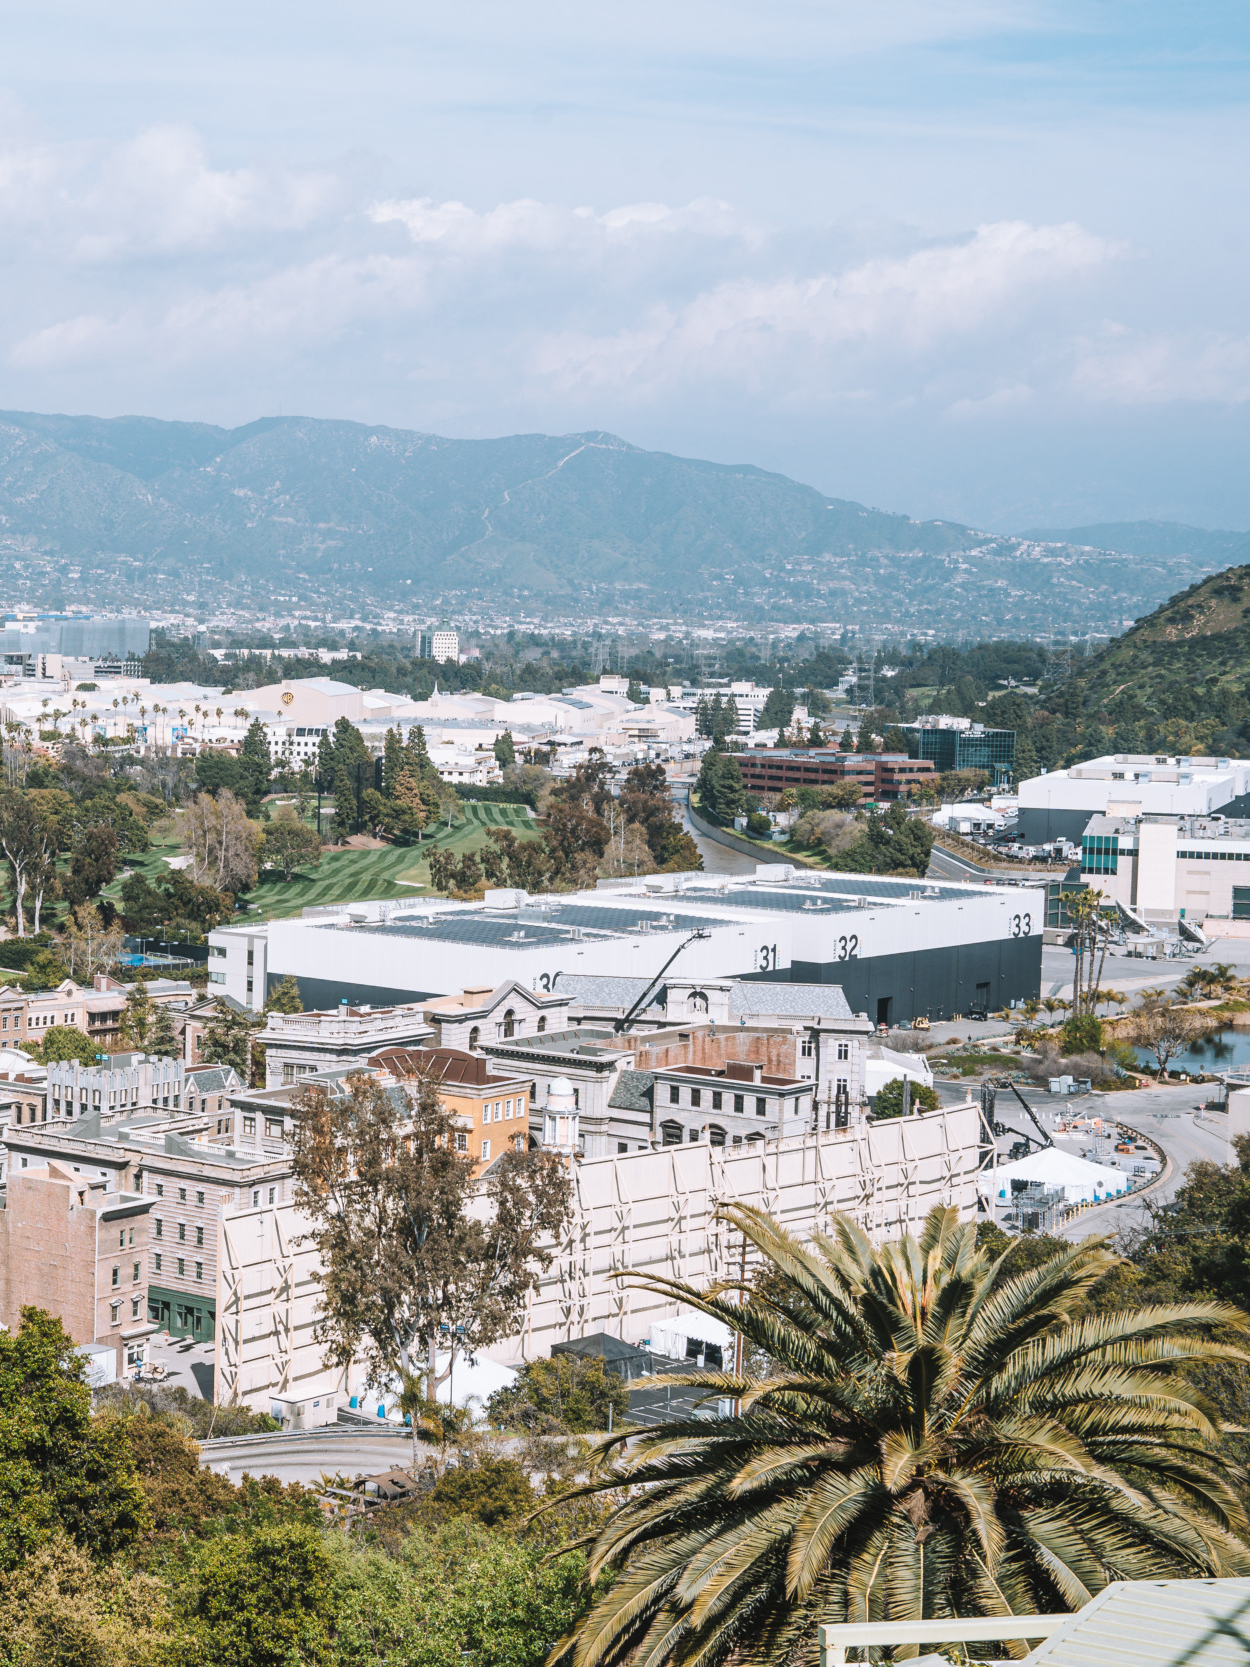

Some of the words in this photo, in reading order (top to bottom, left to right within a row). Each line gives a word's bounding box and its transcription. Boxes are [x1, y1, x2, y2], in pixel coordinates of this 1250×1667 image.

[1013, 912, 1031, 938] 33
[759, 943, 777, 971] 31
[838, 934, 858, 961] 32
